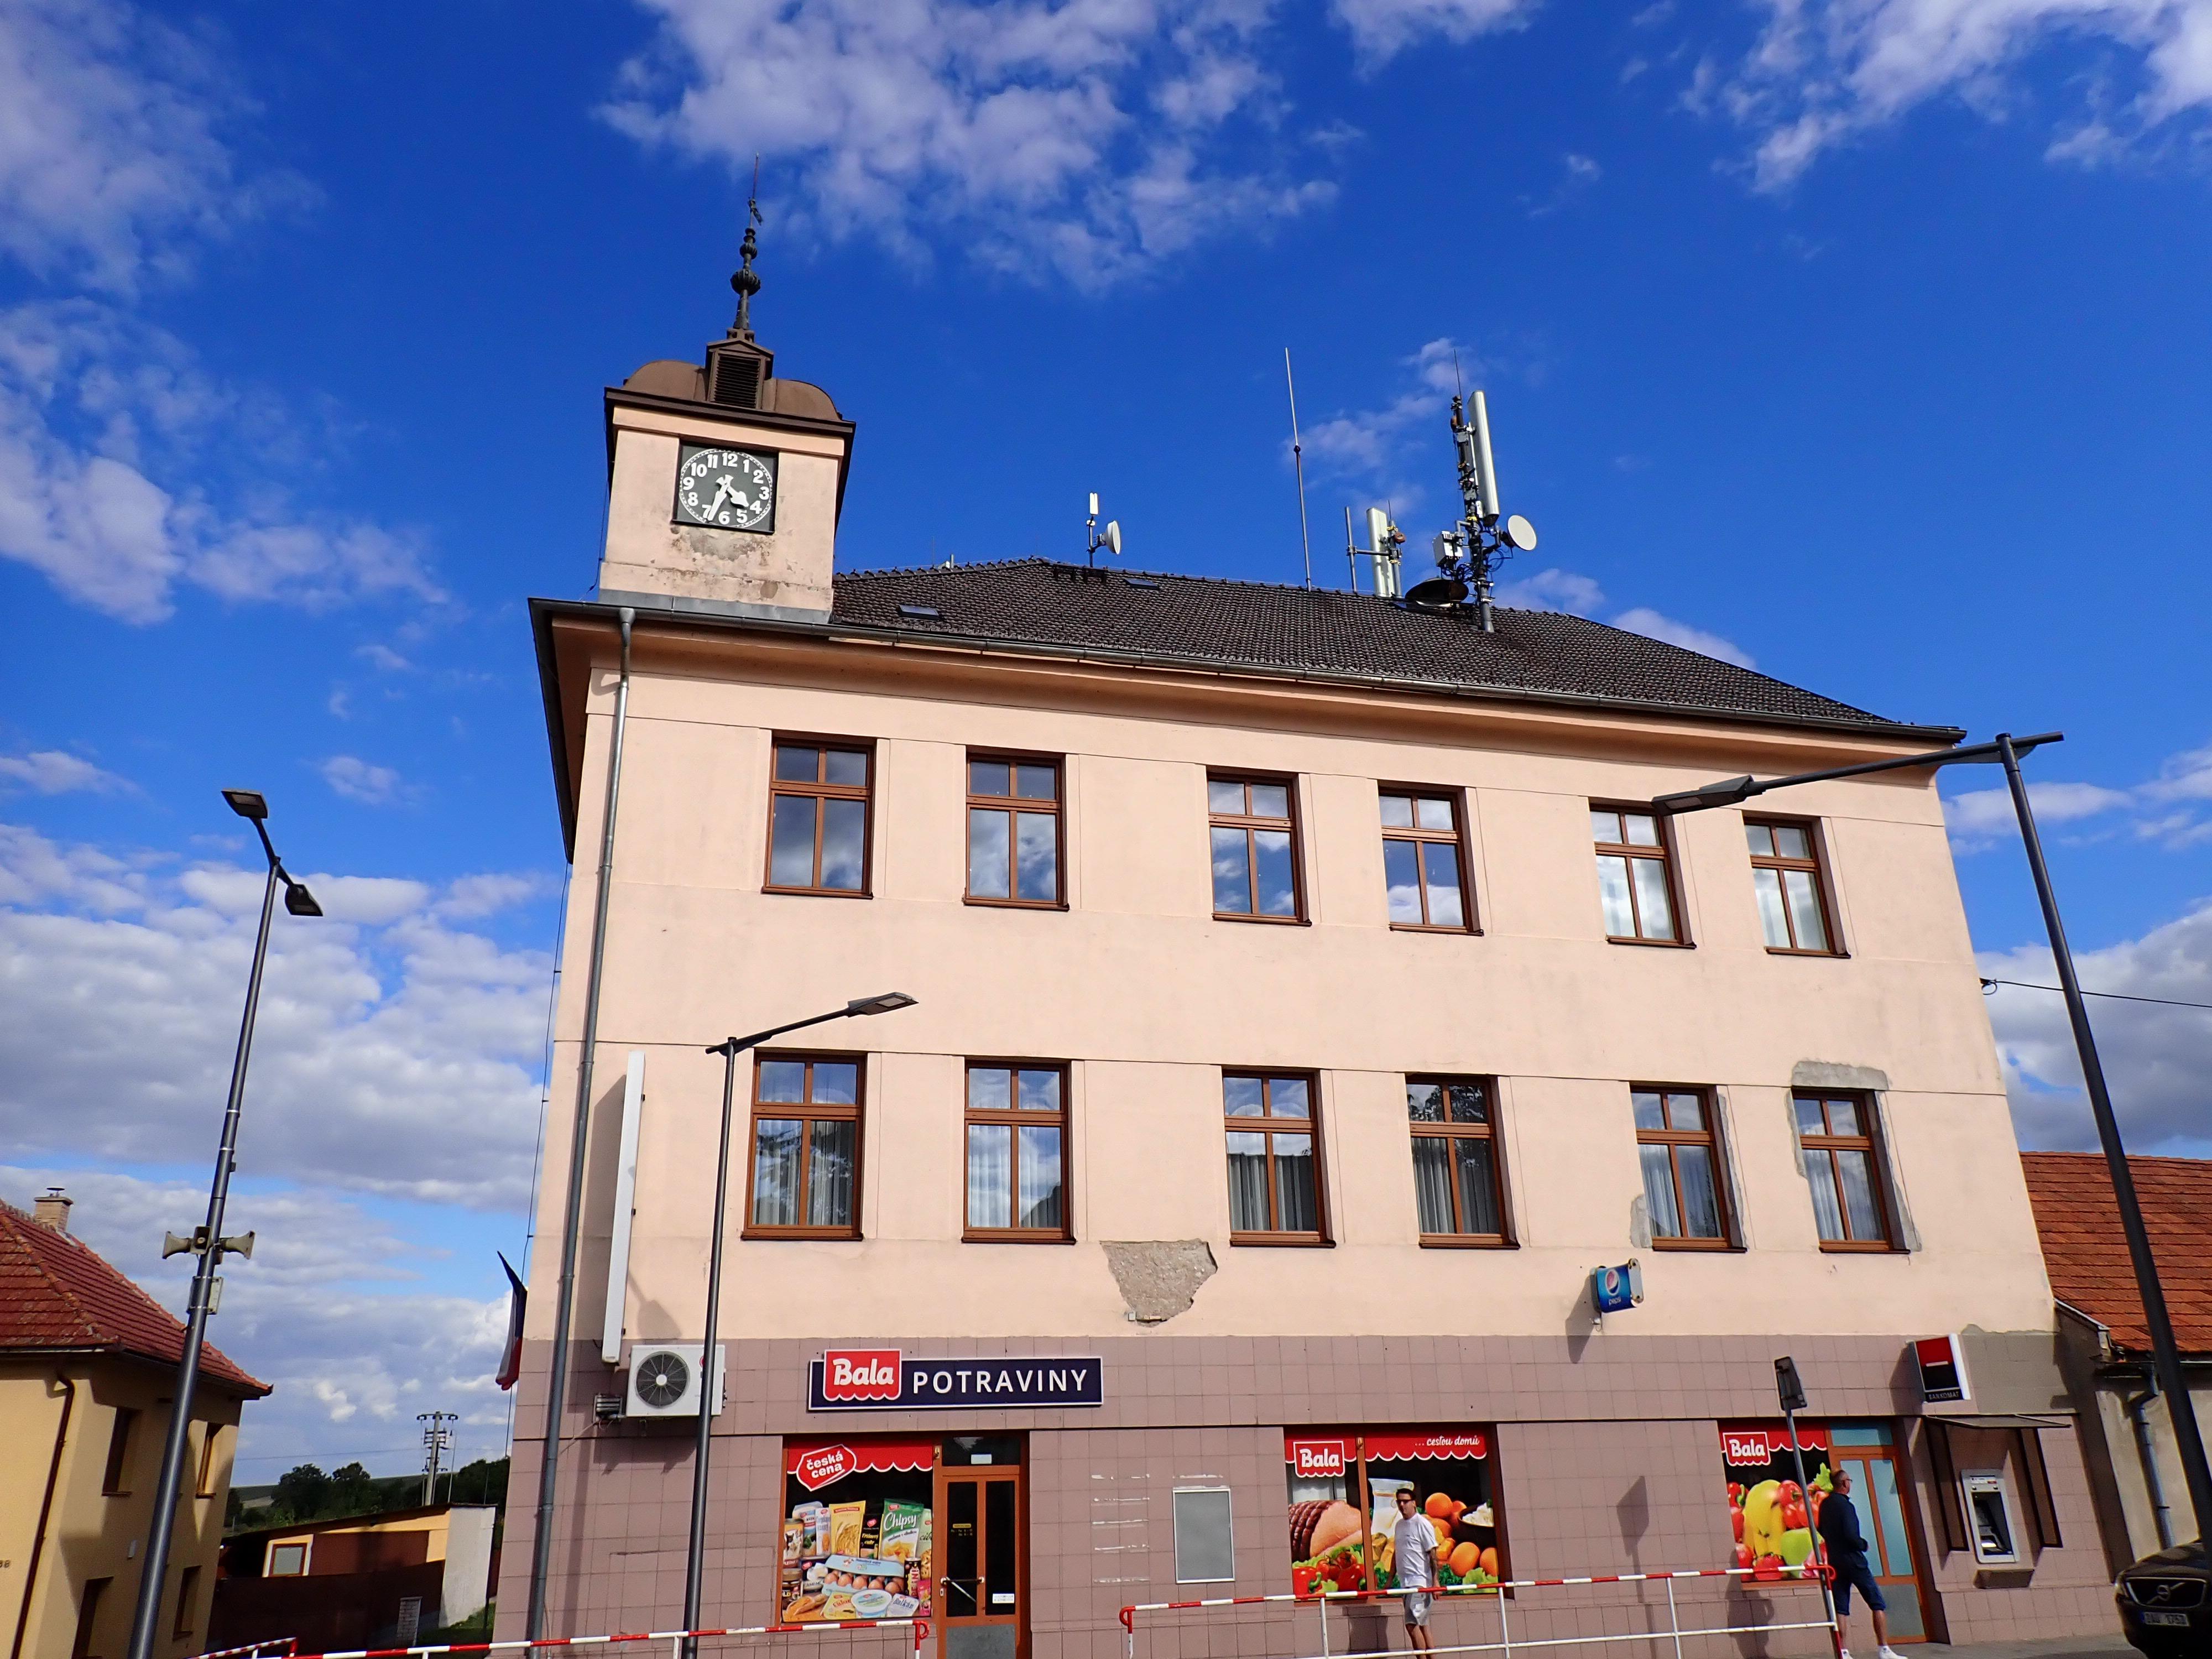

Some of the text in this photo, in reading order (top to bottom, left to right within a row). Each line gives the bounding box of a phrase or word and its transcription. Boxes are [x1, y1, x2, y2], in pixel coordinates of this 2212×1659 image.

[707, 454, 718, 468] 11
[722, 452, 738, 467] 12
[743, 460, 750, 473] 1
[691, 462, 707, 477] 10
[753, 469, 764, 484] 2
[682, 477, 695, 491] 9
[687, 492, 698, 507] 8
[759, 486, 770, 500] 3
[702, 504, 712, 519] 7
[749, 500, 763, 514] 4
[718, 511, 730, 525] 6
[737, 508, 748, 524] 5
[832, 1358, 1088, 1394] Bala POTRAVINY
[1928, 1391, 1959, 1400] BANKOMAT
[1729, 1438, 1765, 1457] Bala
[806, 1450, 844, 1471] česká
[1299, 1448, 1340, 1468] Bala
[811, 1463, 843, 1479] cena
[883, 1512, 917, 1531] Chipsy
